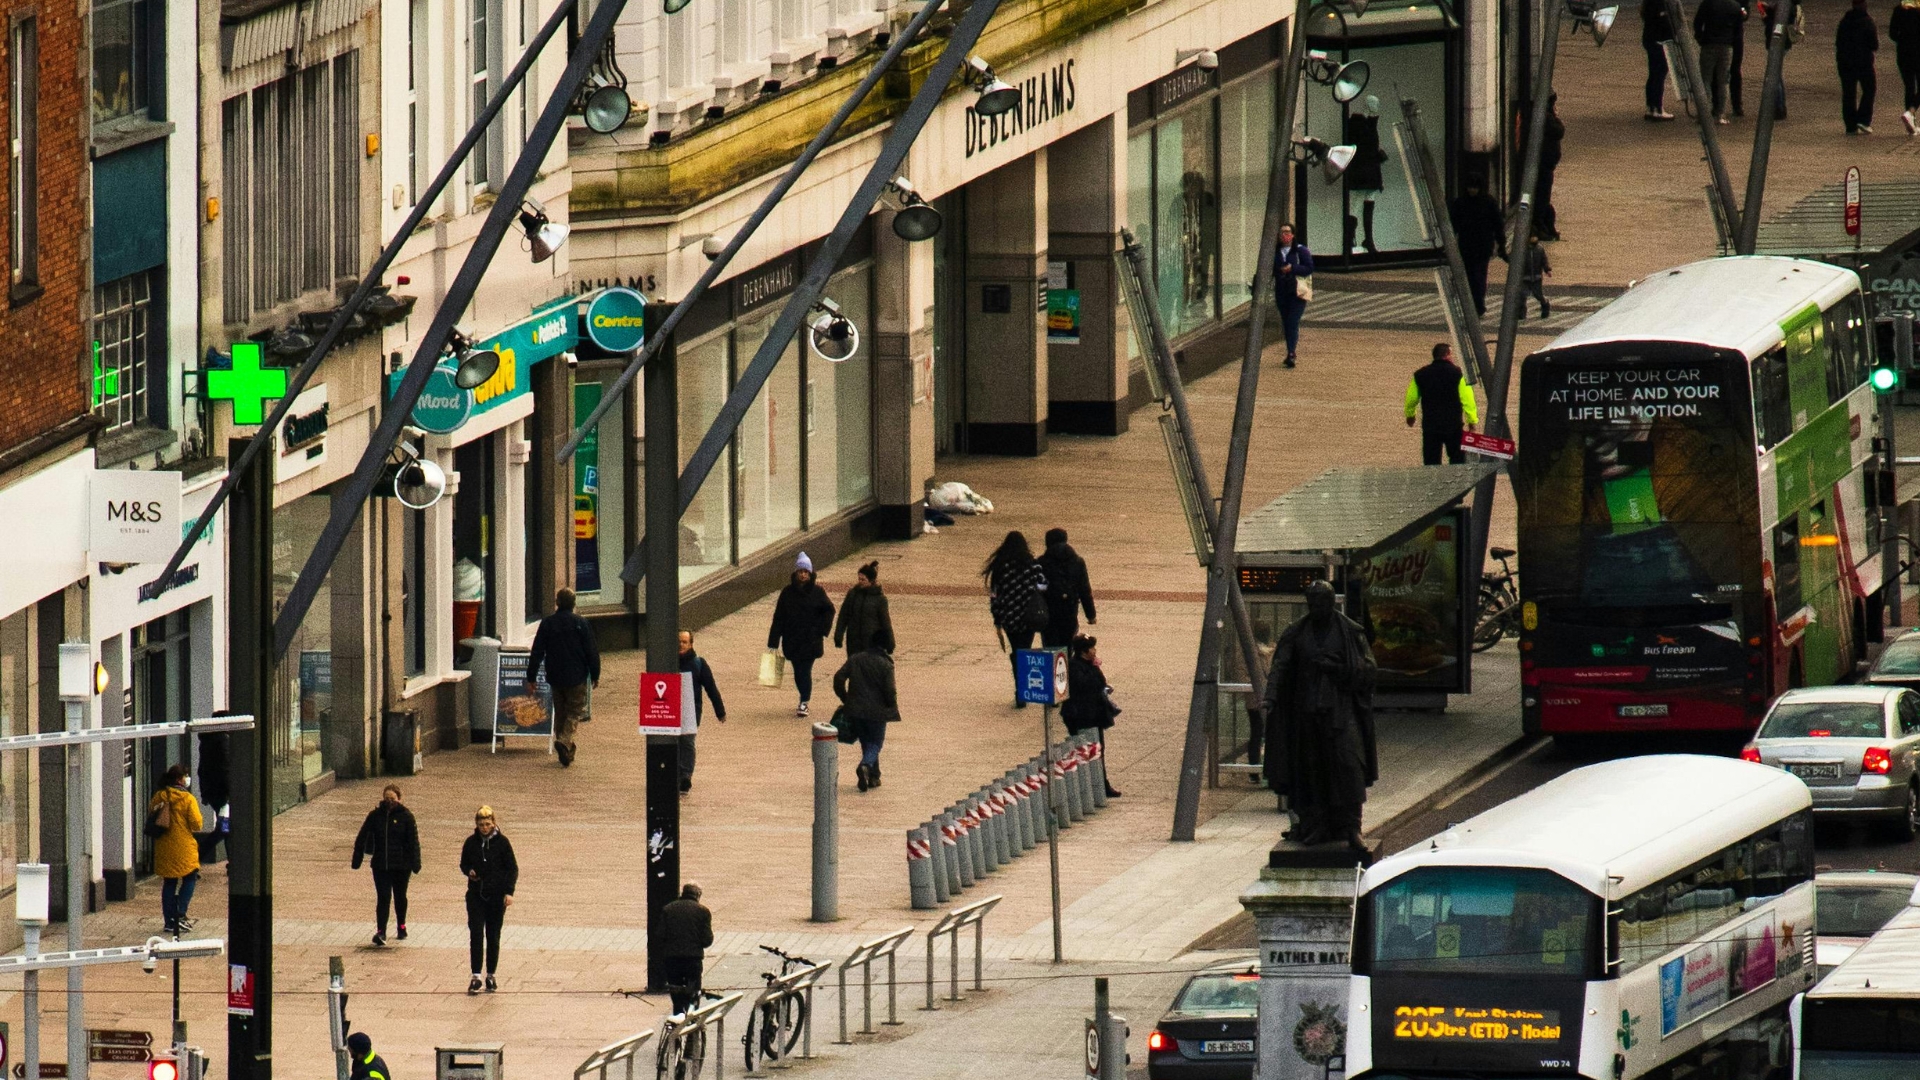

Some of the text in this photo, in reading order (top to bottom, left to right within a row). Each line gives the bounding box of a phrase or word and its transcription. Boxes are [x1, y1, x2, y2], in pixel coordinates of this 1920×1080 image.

[1163, 67, 1208, 104] DEBENHAMS
[965, 58, 1075, 159] DEBENHAMS
[743, 263, 793, 306] DEBENHAMS
[593, 314, 643, 328] Centra
[1567, 368, 1700, 385] KEEP YOUR CAR
[416, 393, 461, 410] Mood
[1549, 385, 1720, 403] AT HOME. AND YOUR
[1568, 403, 1703, 420] LIFE IN MOTION.
[107, 500, 162, 523] M&S
[1371, 584, 1413, 598] CHICKEN
[1644, 645, 1696, 655] Bus Éireann
[501, 657, 527, 666] STUDENT
[1026, 655, 1045, 667] TAXI
[1023, 690, 1050, 702] Q Here
[1270, 951, 1315, 963] FATHER
[1394, 1006, 1445, 1037] 205
[1469, 1022, 1509, 1039] (ETB)
[1521, 1024, 1561, 1039] Model
